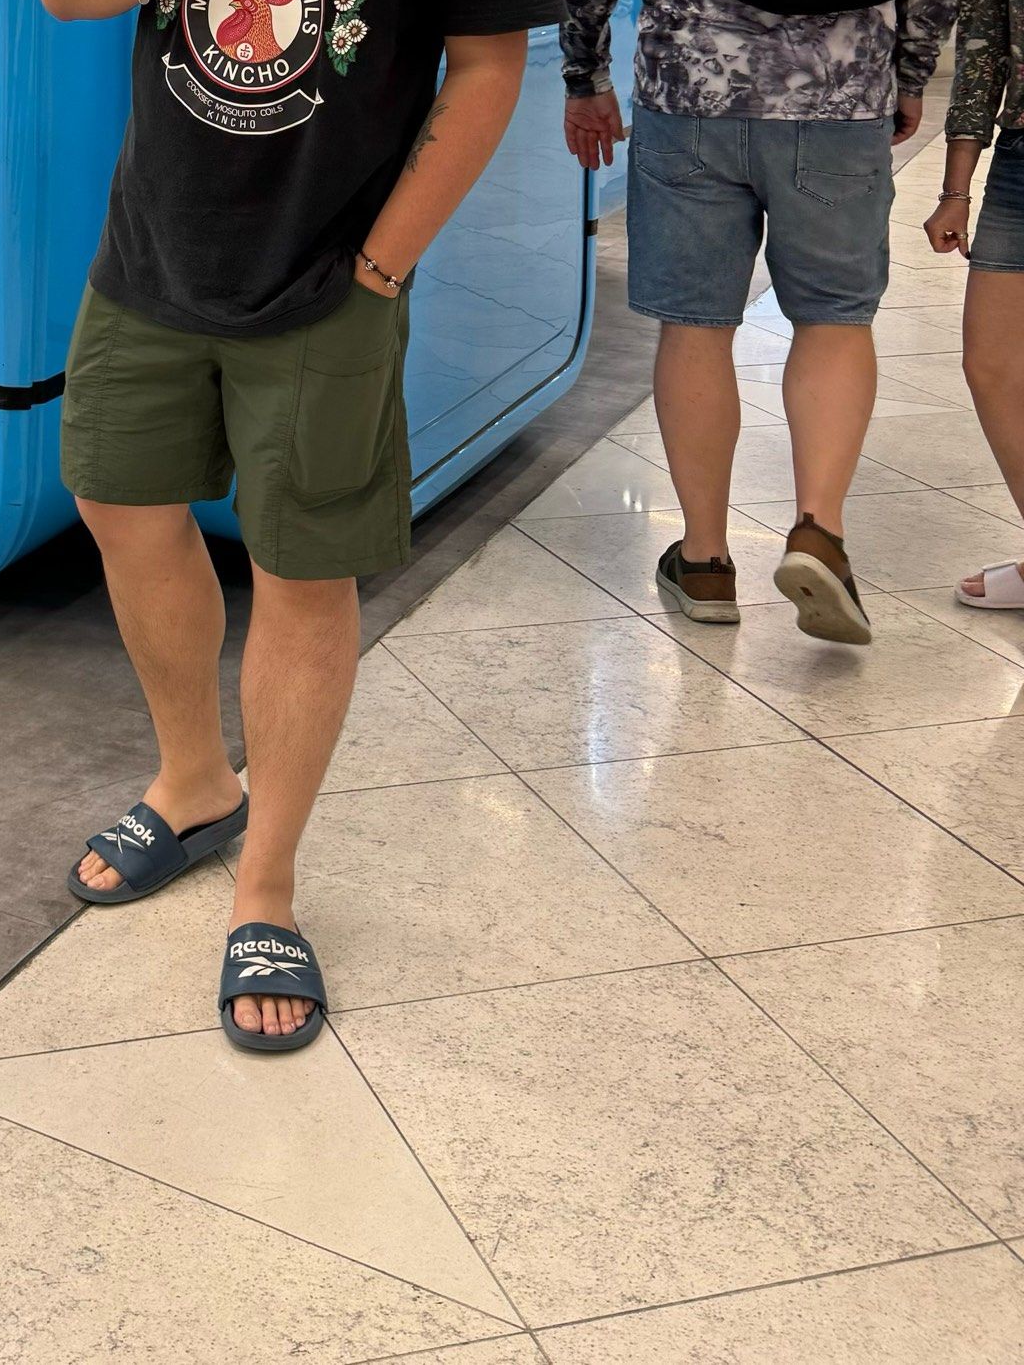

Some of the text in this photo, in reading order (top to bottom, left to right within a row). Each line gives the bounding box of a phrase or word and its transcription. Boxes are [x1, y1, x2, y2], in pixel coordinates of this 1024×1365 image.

[203, 44, 290, 84] KINCHO
[206, 109, 256, 129] KINCHO
[214, 103, 257, 118] MOSQUITO
[260, 104, 284, 117] COILS
[118, 814, 156, 846] ebok
[229, 938, 309, 963] Reebok
